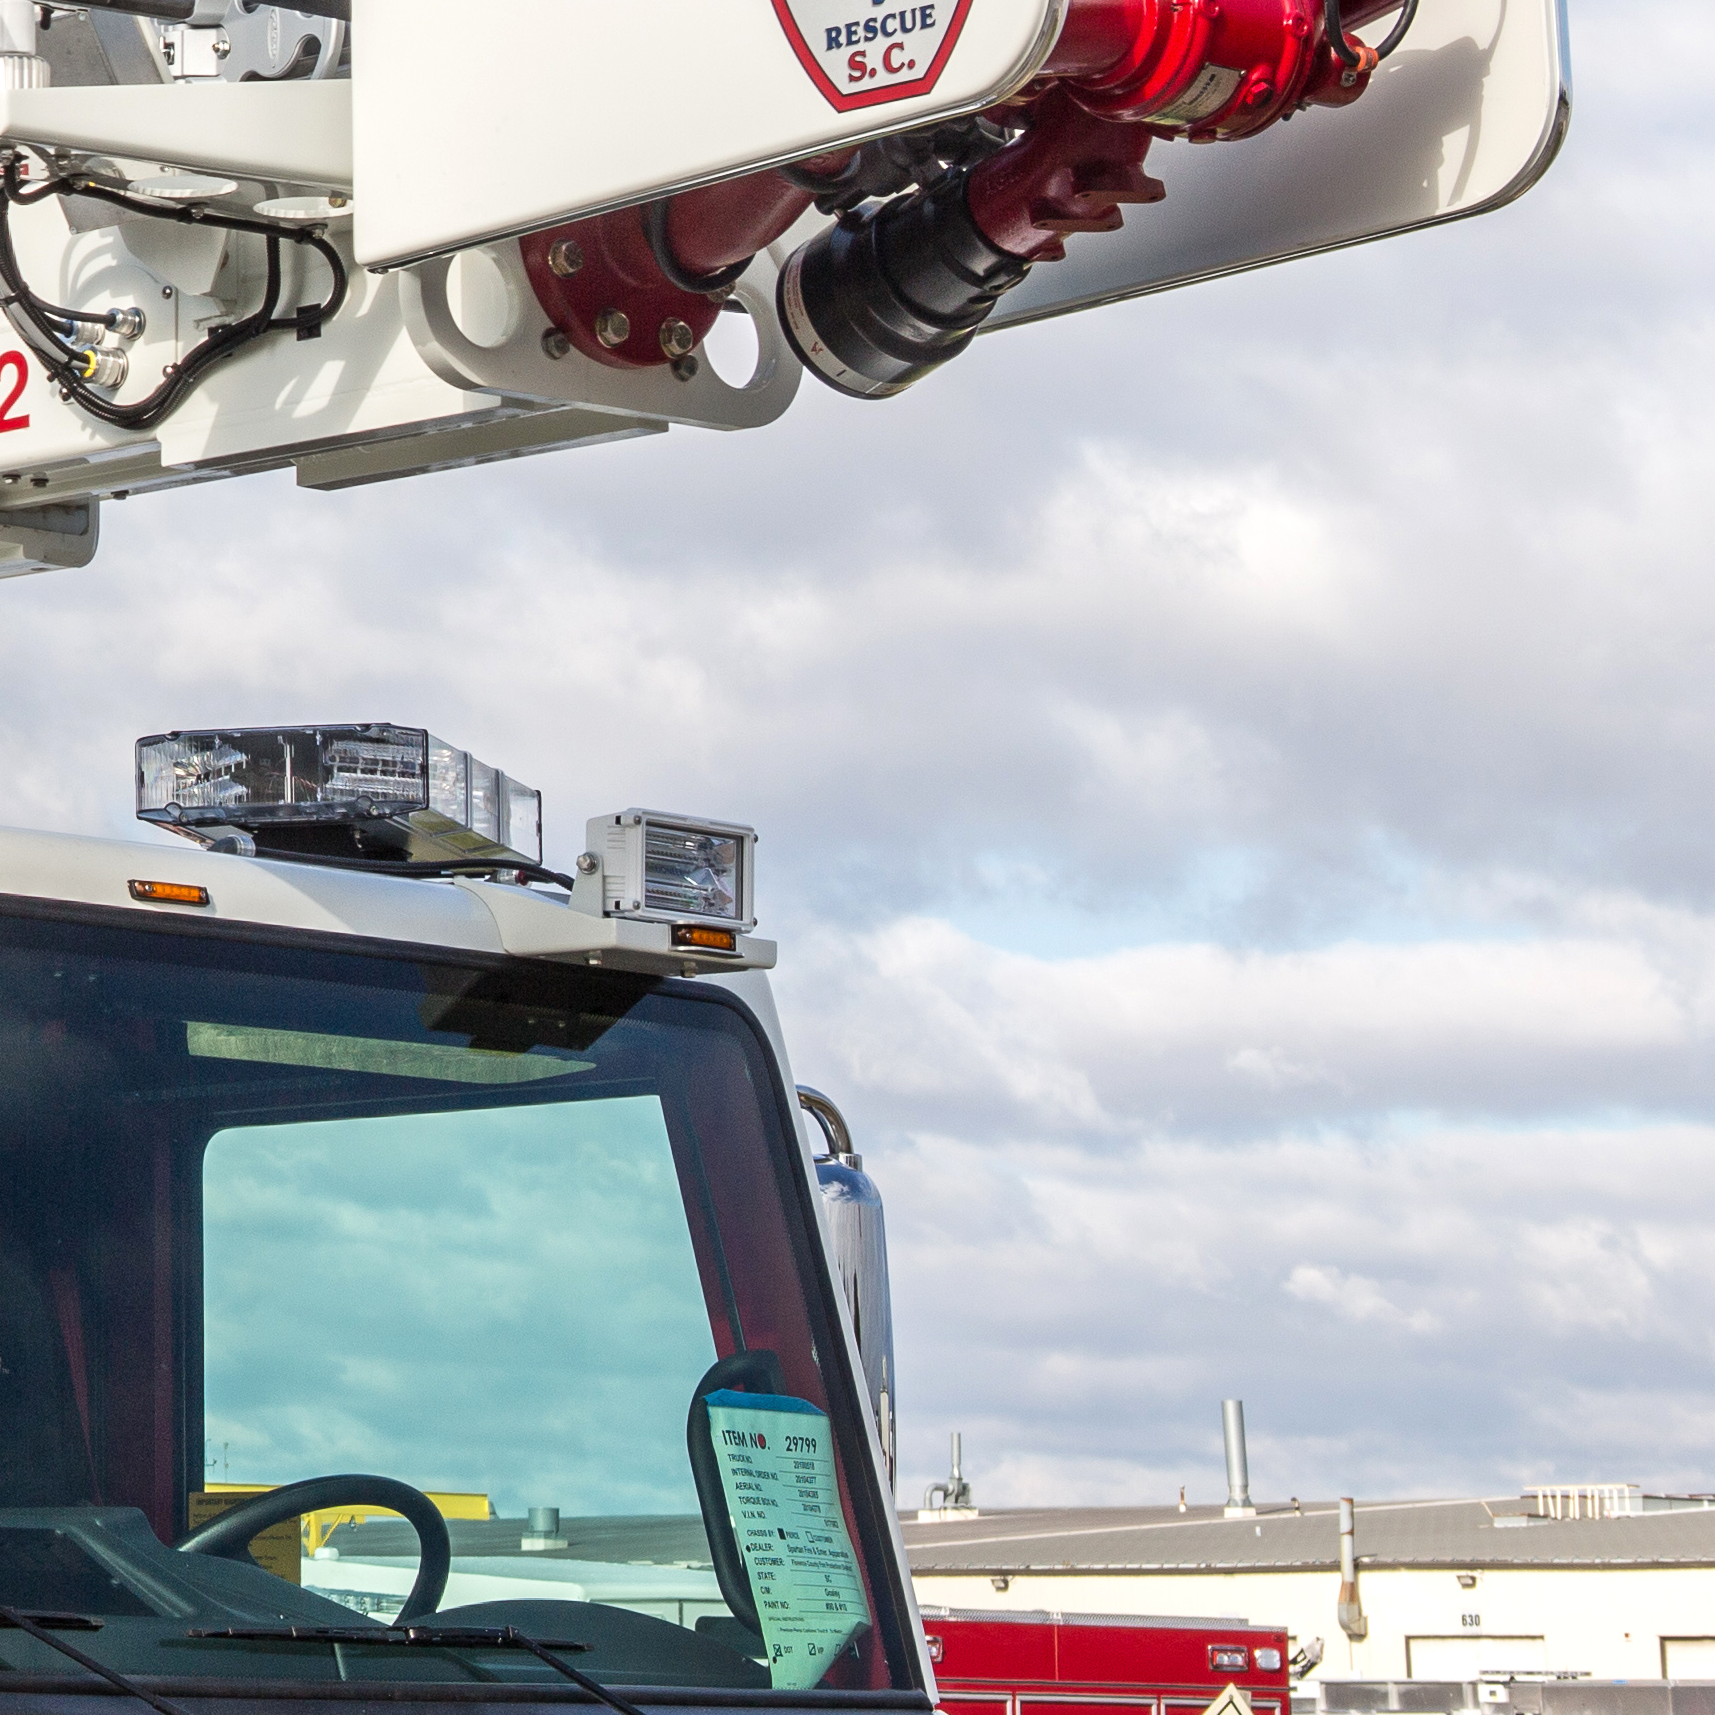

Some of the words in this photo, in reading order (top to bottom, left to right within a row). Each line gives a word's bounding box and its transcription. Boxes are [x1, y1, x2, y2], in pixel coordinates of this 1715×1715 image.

[825, 4, 936, 51] RESCUE
[722, 1430, 748, 1448] ITEM
[750, 1433, 771, 1451] NO.
[785, 1435, 817, 1454] 29799
[750, 1543, 774, 1552] DEALER:
[757, 1571, 776, 1581] STATE:
[1461, 1614, 1480, 1627] 630
